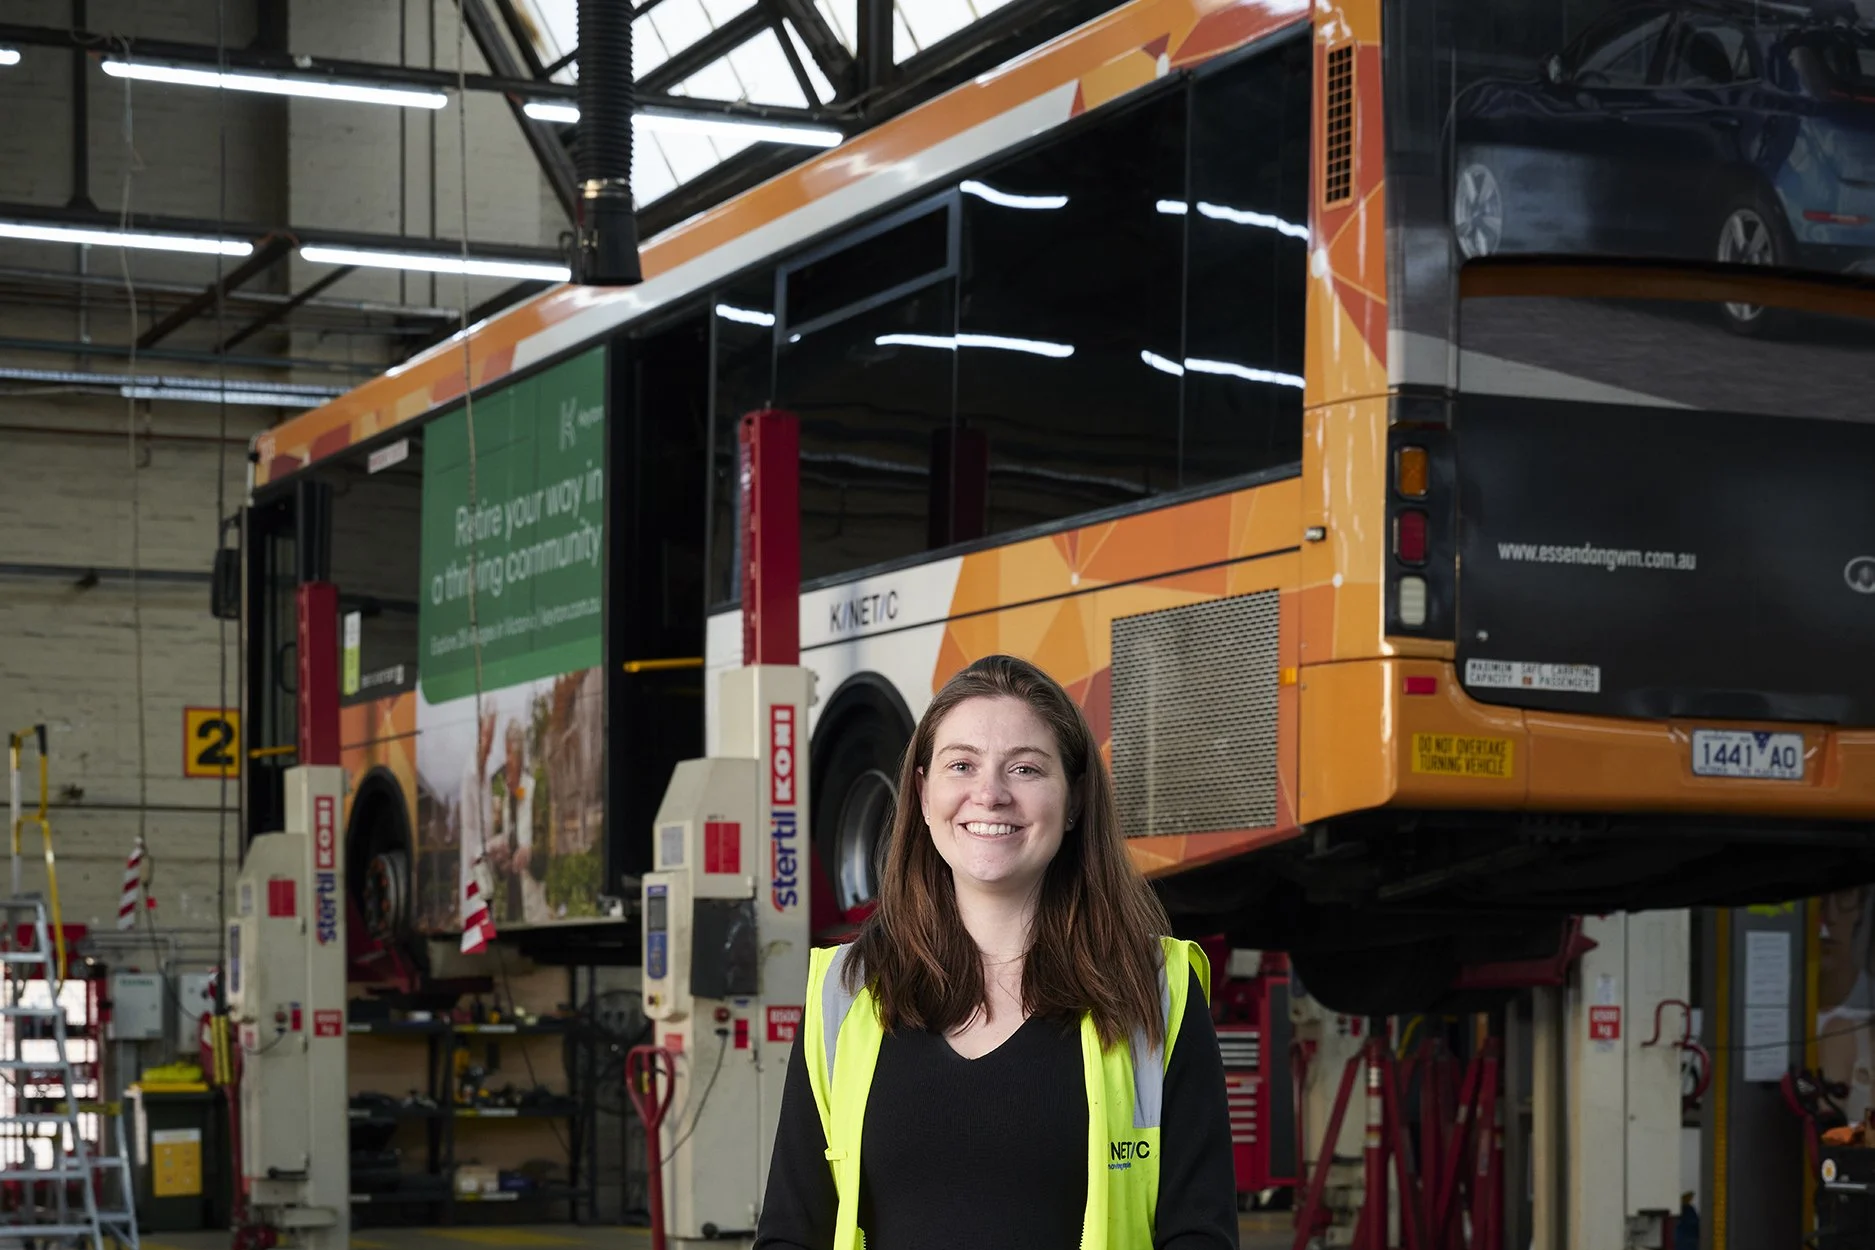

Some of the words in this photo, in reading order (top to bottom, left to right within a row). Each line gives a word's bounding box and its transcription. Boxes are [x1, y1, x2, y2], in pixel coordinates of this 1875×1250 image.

[455, 498, 501, 547] Retire
[505, 489, 544, 542] your
[546, 475, 584, 519] way
[586, 459, 603, 503] in
[431, 575, 444, 605] a
[445, 550, 503, 597] thriing
[505, 518, 602, 584] community
[1498, 541, 1696, 571] www.essendongwm.com.au
[1470, 662, 1512, 673] MAXIMUM
[1522, 664, 1542, 675] SAFE
[1552, 665, 1595, 677] CARRYING
[1470, 673, 1512, 684] CAPACITY
[1540, 676, 1595, 690] PASSENGERS
[197, 718, 235, 766] 2
[775, 709, 791, 801] KONI
[1418, 736, 1432, 752] DO
[1435, 737, 1454, 754] NOT
[1457, 738, 1506, 758] OVERTAKE
[1704, 742, 1752, 768] 1441
[1420, 754, 1461, 772] TURNING
[1465, 757, 1506, 777] VEHICLE
[771, 811, 797, 908] stertil
[316, 873, 336, 944] stertil
[777, 1024, 794, 1040] kg
[1110, 1140, 1150, 1161] NETIC
